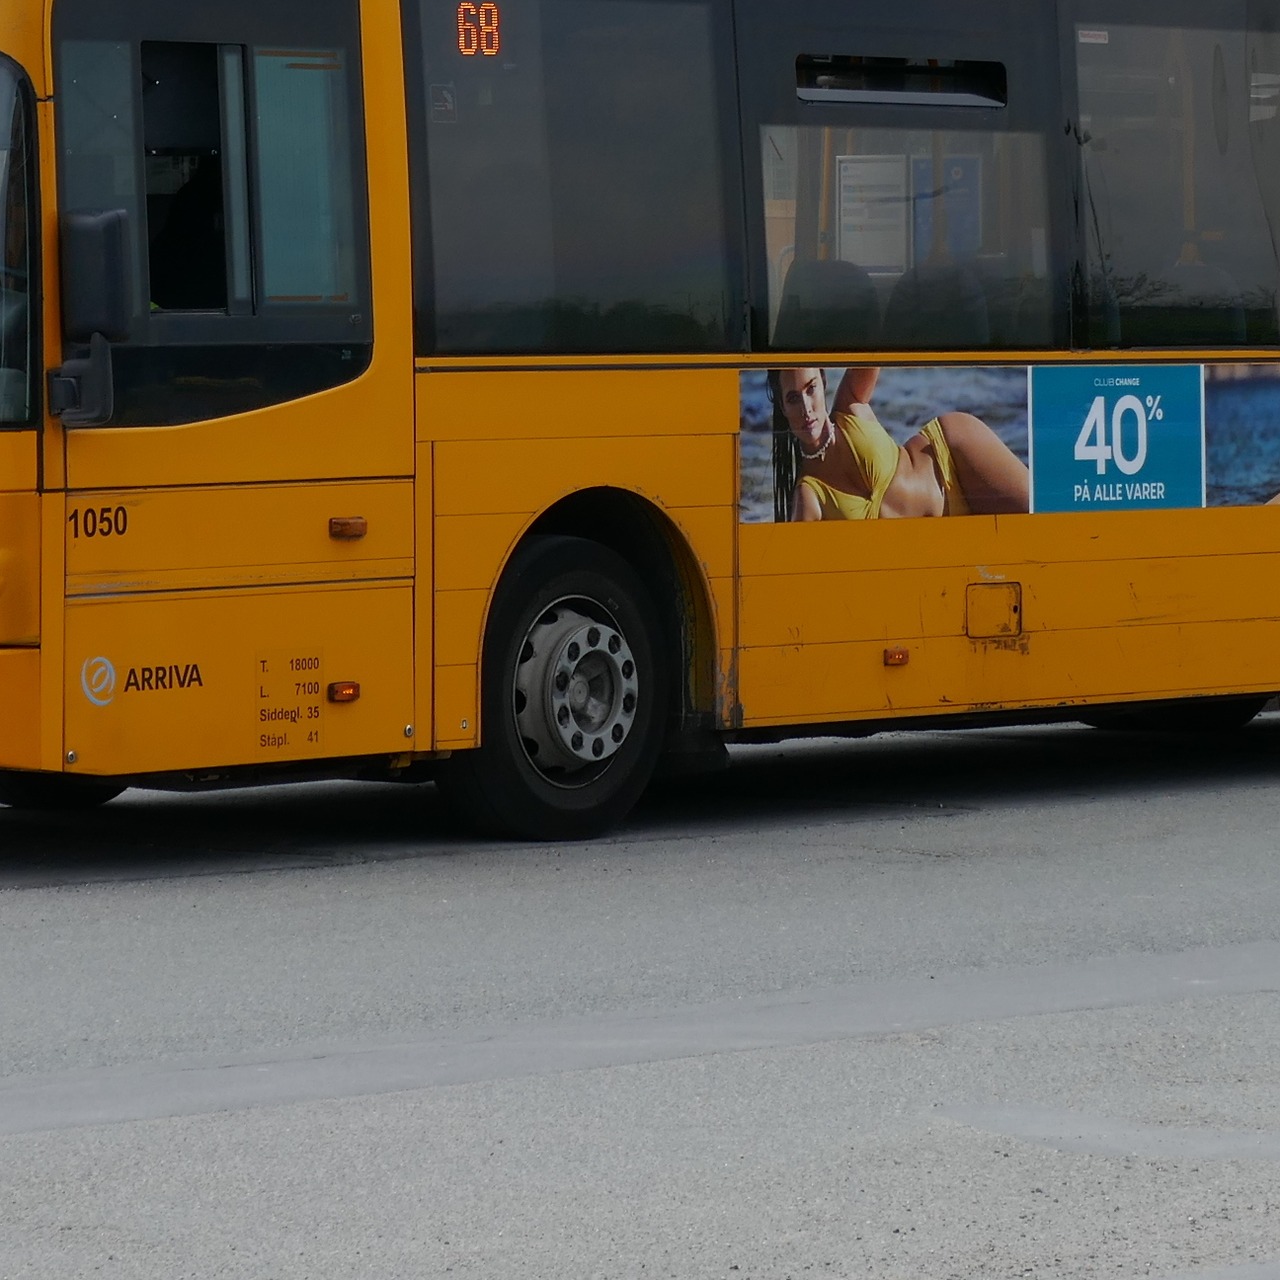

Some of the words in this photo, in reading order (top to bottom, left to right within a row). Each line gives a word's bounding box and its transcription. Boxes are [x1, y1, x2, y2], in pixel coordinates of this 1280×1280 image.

[458, 2, 499, 55] 68
[1115, 378, 1140, 386] CHANGE
[1074, 394, 1163, 475] 40%
[1074, 479, 1091, 502] PÅ
[1094, 483, 1122, 501] ALLE
[1125, 482, 1165, 500] VARER
[65, 506, 127, 539] 1050
[260, 660, 269, 672] T.
[289, 657, 320, 671] 18000
[124, 664, 203, 692] ARRIVA
[260, 685, 270, 698] L.
[295, 682, 320, 696] 7100
[307, 706, 320, 719] 35
[307, 730, 319, 743] 41
